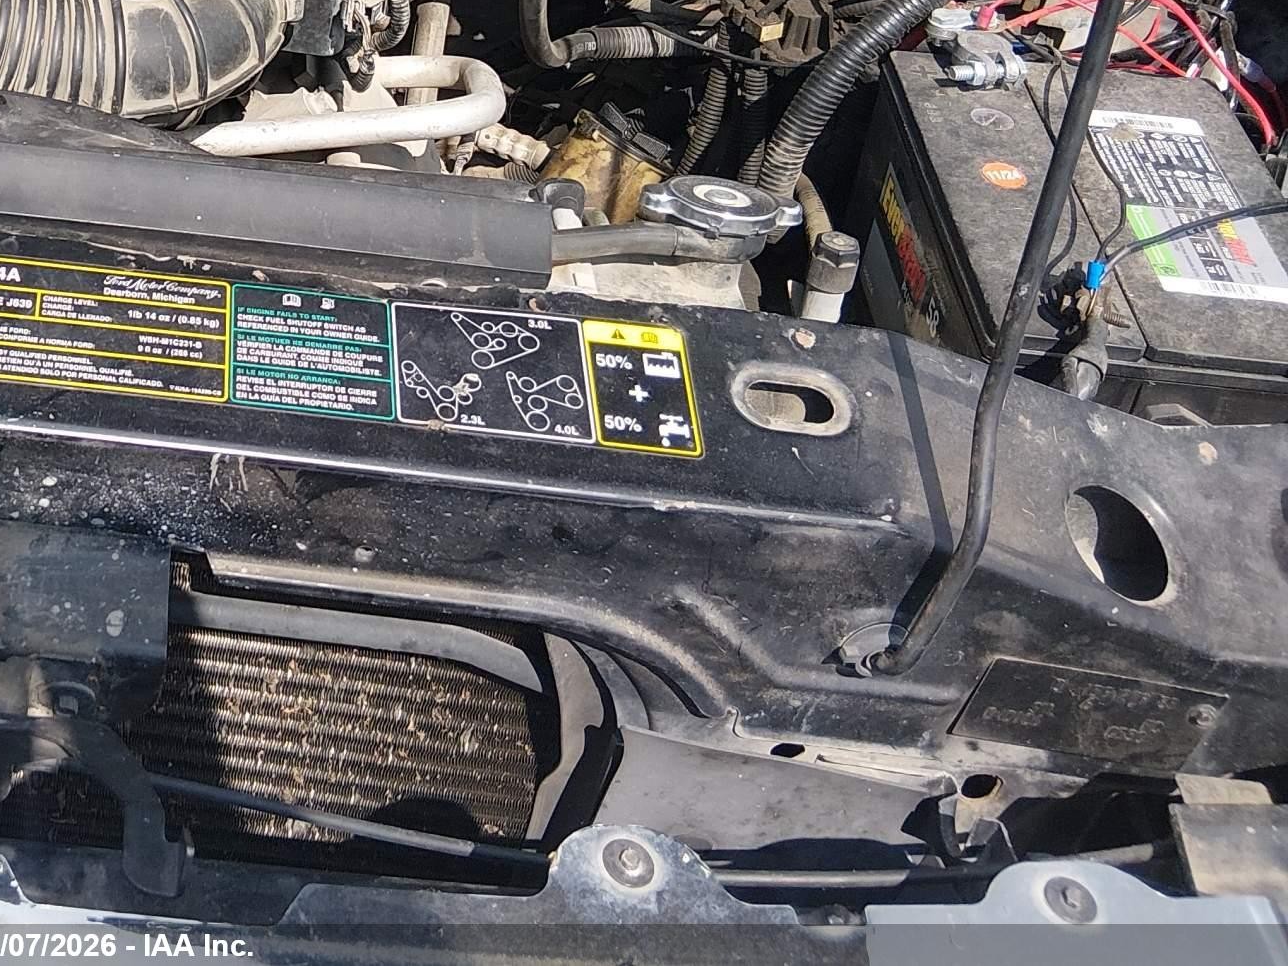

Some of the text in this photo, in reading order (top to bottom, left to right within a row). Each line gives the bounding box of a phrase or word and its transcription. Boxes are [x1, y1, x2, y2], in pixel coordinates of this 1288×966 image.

[103, 274, 164, 293] Ford Motor
[6, 297, 32, 308] J639
[42, 295, 98, 306] CHARGE LEVEL:
[103, 287, 194, 304] Dearborn, Michigan
[41, 309, 65, 317] CARGA
[78, 313, 112, 322] LLENADO:
[127, 309, 142, 320] 1lb
[144, 311, 155, 321] 14
[158, 313, 170, 323] oz
[177, 315, 201, 326] (0.85
[203, 318, 219, 328] kg)
[246, 307, 274, 315] ENGINE
[276, 310, 297, 318] FAILS
[311, 314, 337, 322] START:
[237, 313, 263, 322] CHECK
[265, 316, 284, 324] FUEL
[286, 318, 321, 328] SHUTOFF
[323, 322, 353, 331] SWITCH
[528, 319, 552, 330] 3.0L
[8, 326, 31, 335] FORD:
[237, 320, 288, 332] REFERENCED
[300, 327, 321, 336] YOUR
[323, 330, 352, 339] OWNER
[353, 333, 379, 342] GUIDE.
[45, 338, 71, 346] NORMA
[8, 350, 46, 360] QUALIFIED
[152, 346, 162, 354] oz
[189, 350, 202, 359] cc)
[273, 343, 283, 351] LA
[285, 344, 330, 356] COMMANDE
[332, 349, 343, 358] DE
[344, 350, 382, 362] COUPURE
[300, 353, 329, 363] COMME
[54, 362, 97, 372] PERSONNEL
[236, 354, 258, 362] DANS
[260, 356, 269, 364] LE
[271, 357, 296, 366] GUIDE
[297, 360, 308, 368] DE
[595, 352, 633, 370] 50%
[2, 363, 38, 374] ATENDIDO
[61, 370, 77, 378] POR
[78, 371, 117, 382] PERSONAL
[118, 375, 162, 387] CALIFICADO.
[257, 370, 286, 378] MOTOR
[301, 375, 340, 384] ARRANCA:
[235, 375, 264, 384] REVISE
[266, 378, 276, 386] EL
[277, 379, 333, 392] INTERRUPTOR
[335, 385, 345, 393] DE
[235, 383, 376, 405] DEL COMBUSTIBLE COMO SE INDICA
[235, 389, 246, 399] EN
[248, 391, 258, 400] LA
[281, 394, 297, 404] DEL
[299, 396, 353, 410] PROPIETARIO.
[460, 413, 486, 425] 2.3L
[604, 415, 643, 433] 50%
[554, 423, 579, 436] 4.0L
